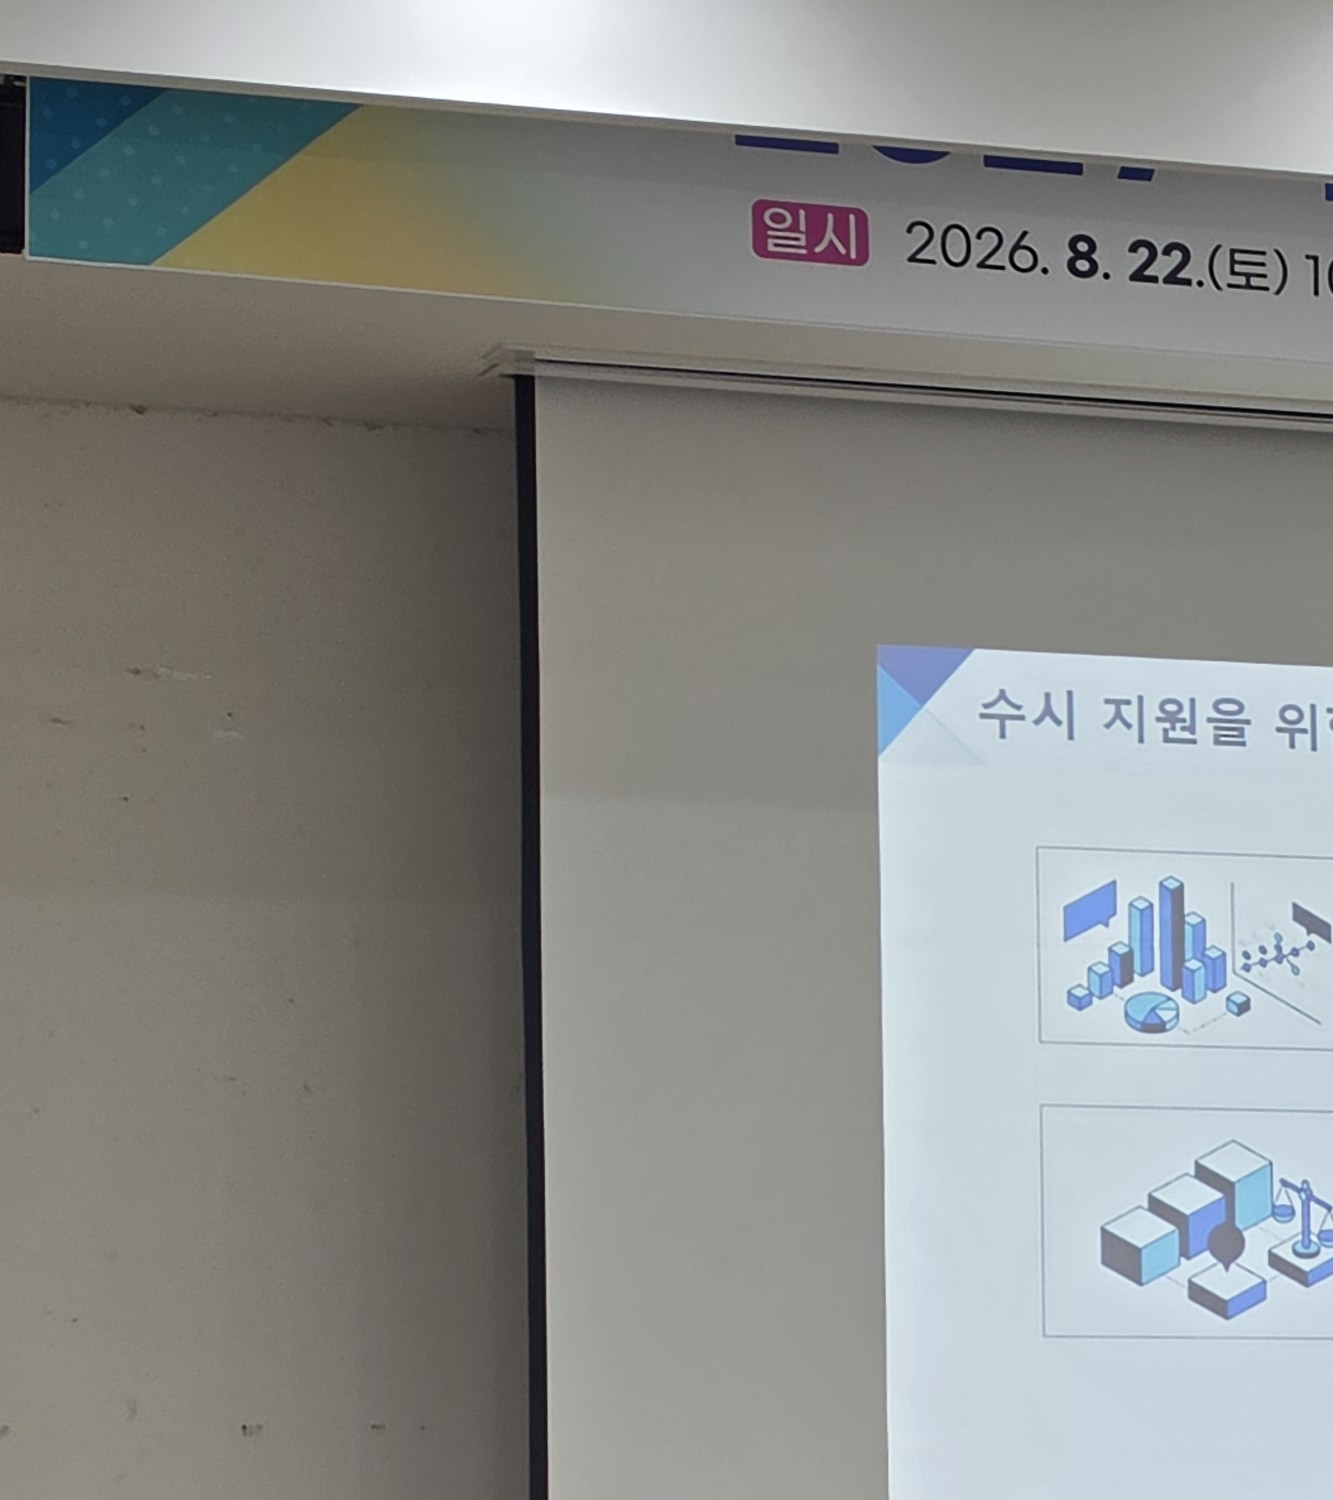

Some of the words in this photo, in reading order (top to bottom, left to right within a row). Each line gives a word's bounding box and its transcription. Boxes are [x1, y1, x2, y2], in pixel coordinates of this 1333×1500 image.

[763, 207, 857, 260] 일시
[905, 220, 1050, 276] 2026.
[1066, 233, 1111, 281] 8.
[1127, 238, 1288, 296] 22.(토)
[978, 688, 1075, 742] 수시
[1102, 694, 1252, 748] 지원을
